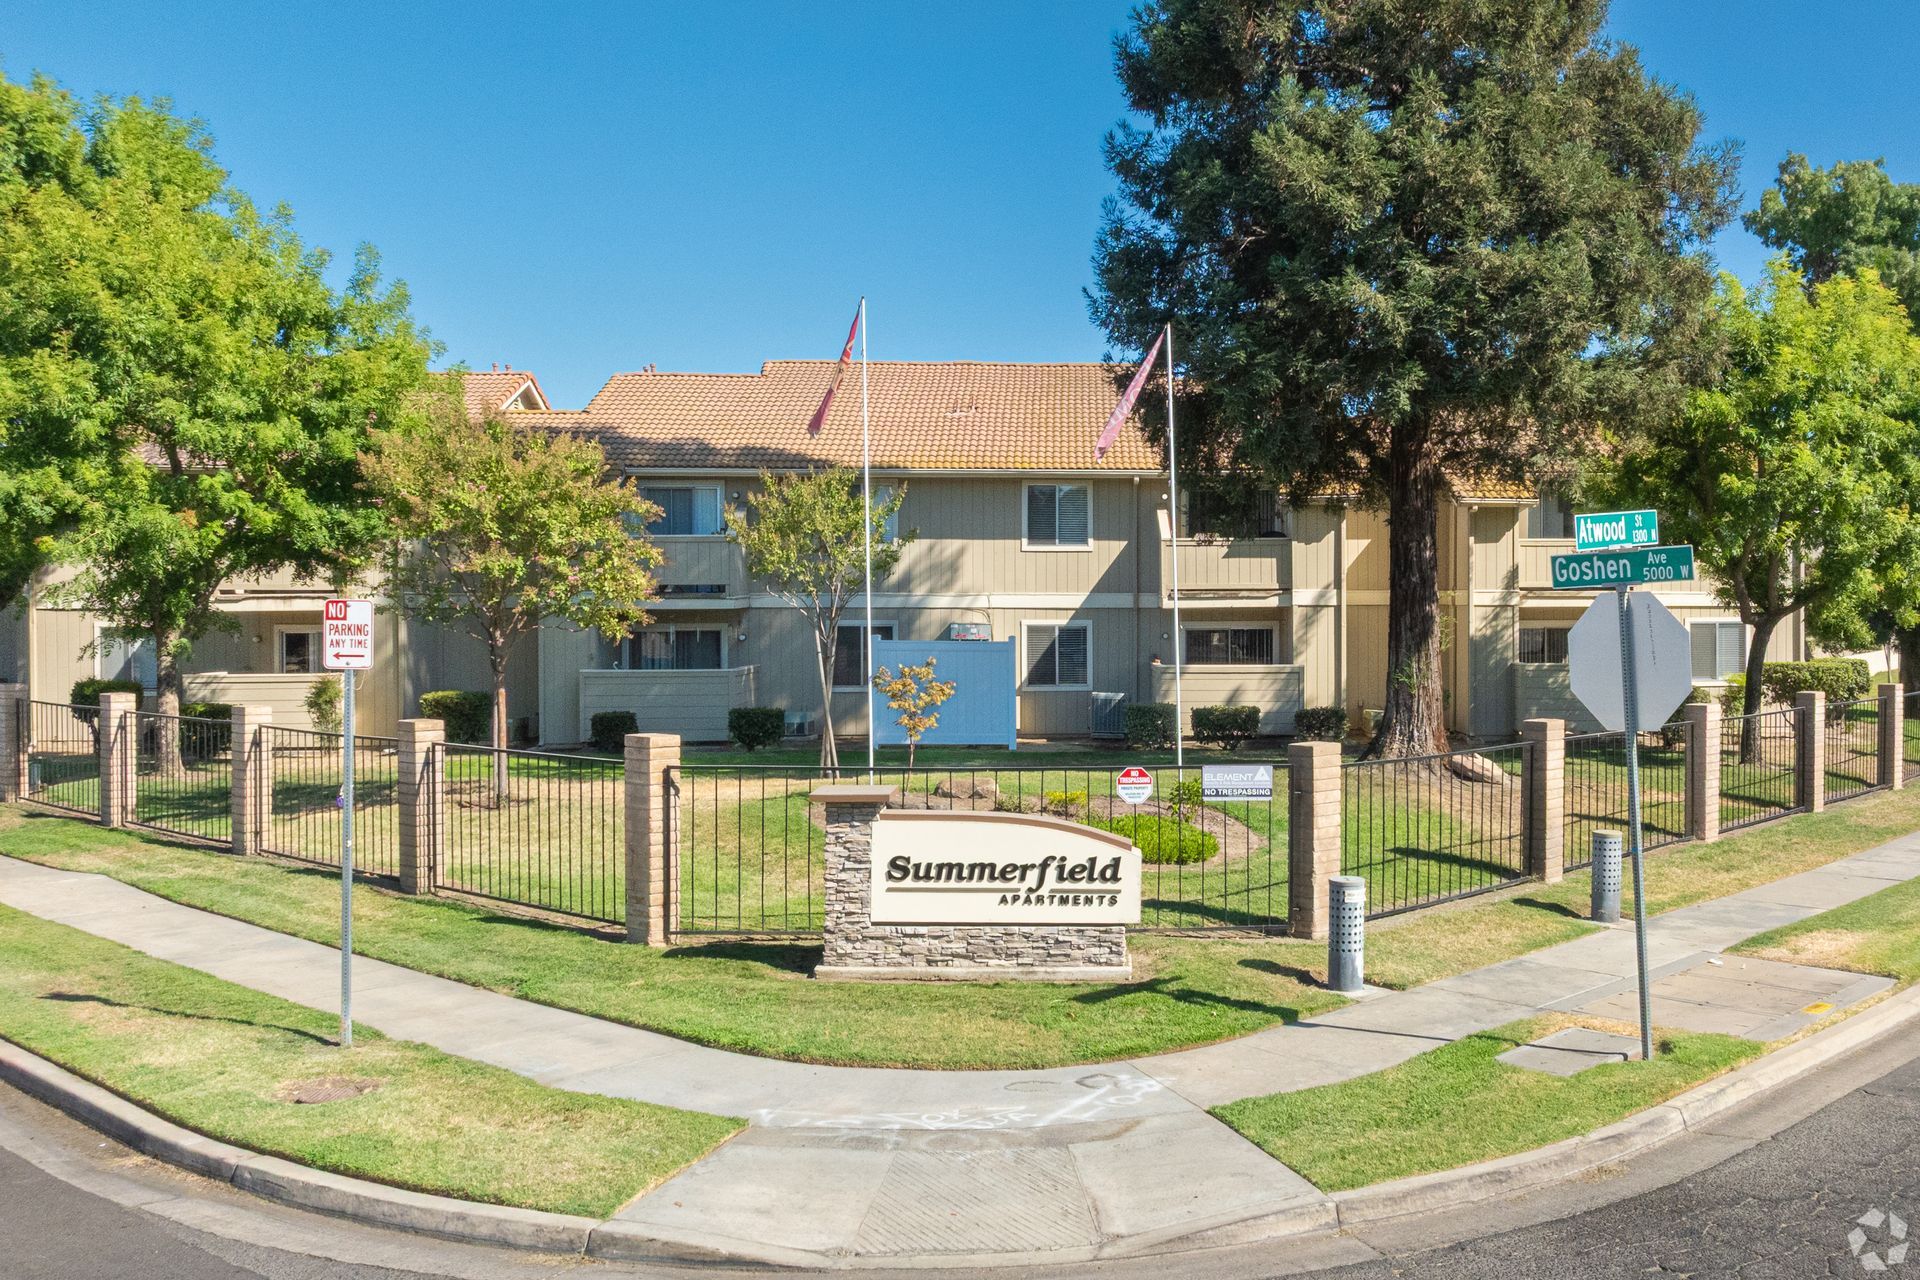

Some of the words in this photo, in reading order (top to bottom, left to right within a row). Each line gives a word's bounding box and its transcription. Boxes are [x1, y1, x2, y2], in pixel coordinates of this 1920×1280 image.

[1634, 514, 1643, 527] St
[1578, 515, 1626, 544] Atwood
[1632, 529, 1648, 543] 1300
[1651, 528, 1657, 541] N
[1647, 551, 1667, 564] Ave
[1555, 556, 1632, 582] Goshen
[1643, 566, 1674, 581] 5000
[1680, 564, 1689, 578] W
[328, 602, 345, 618] NO
[328, 623, 369, 636] PARKING
[329, 638, 346, 648] ANY
[350, 638, 368, 648] TIME
[1204, 773, 1253, 781] ELEMENT
[1204, 788, 1217, 796] NO
[1217, 788, 1271, 796] TRESPASSING
[885, 854, 1122, 895] Summerfield
[998, 894, 1119, 907] APARTMENTS
